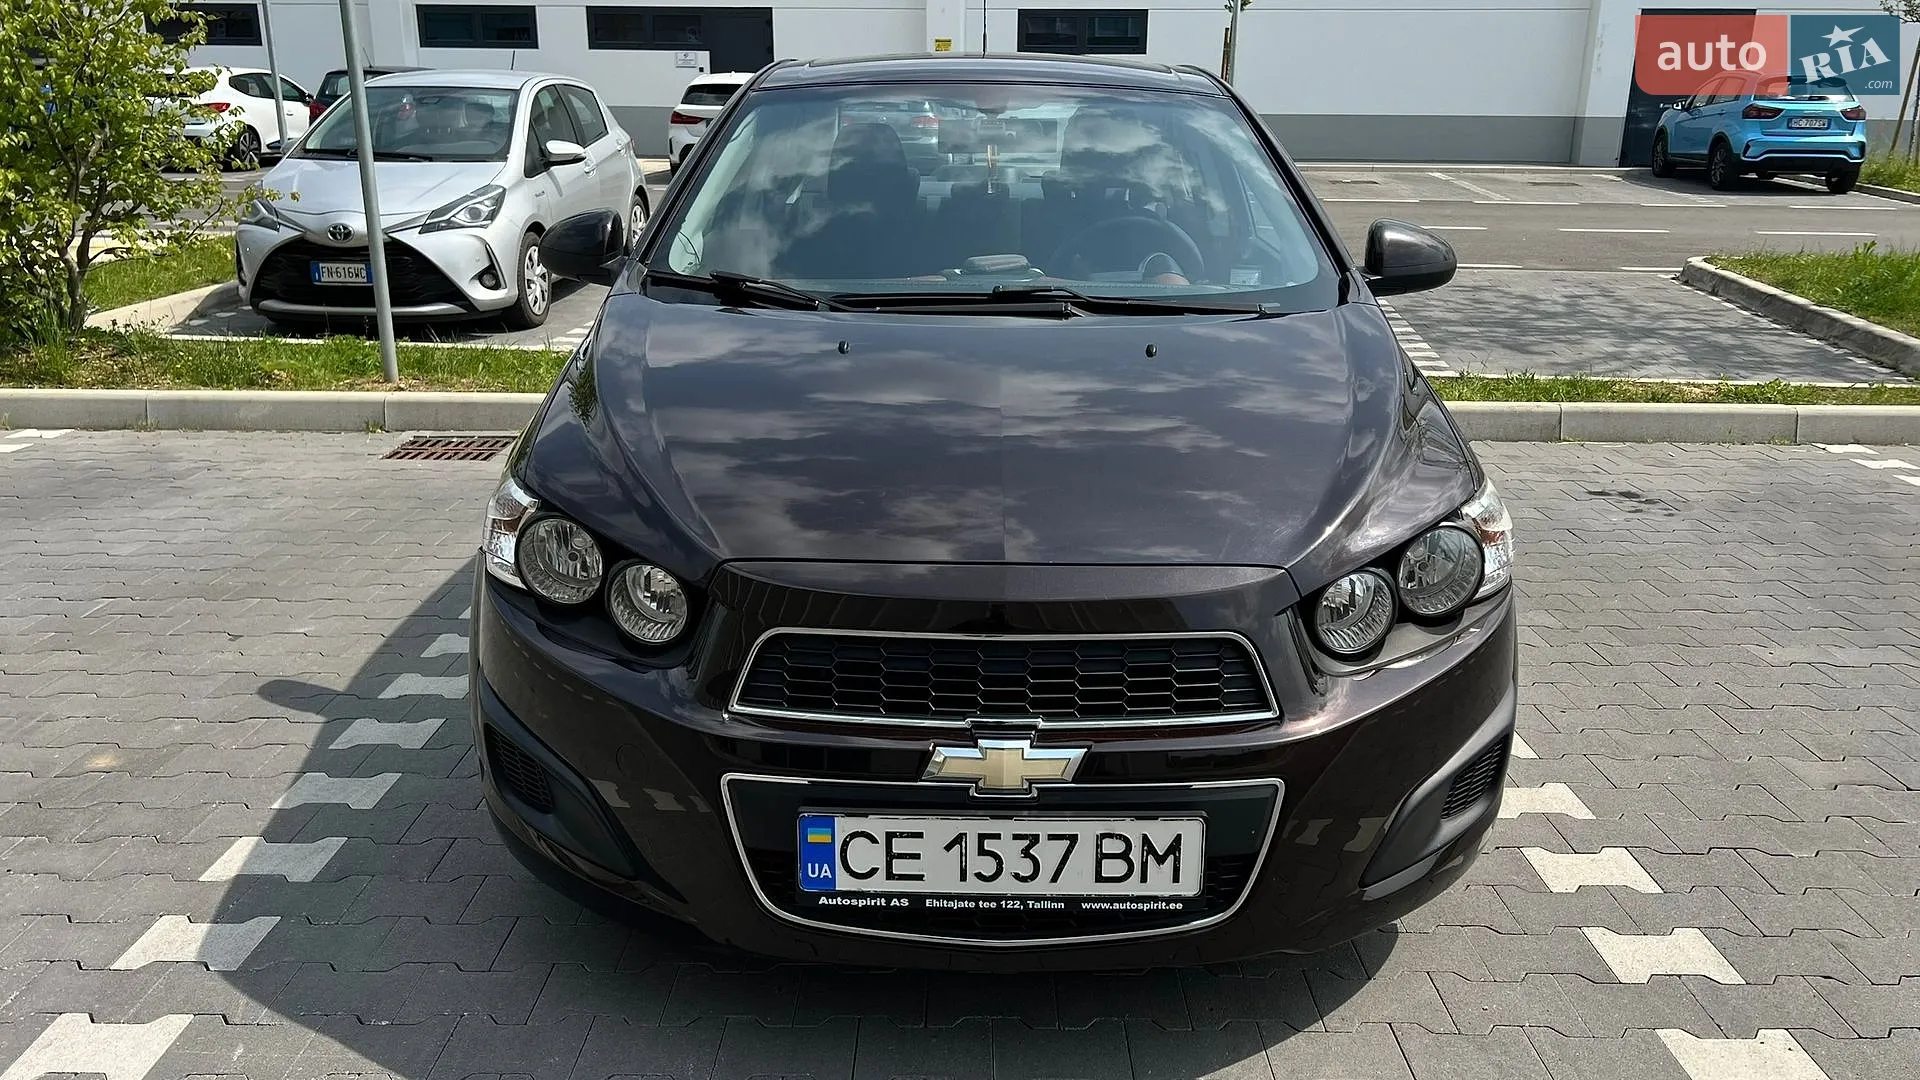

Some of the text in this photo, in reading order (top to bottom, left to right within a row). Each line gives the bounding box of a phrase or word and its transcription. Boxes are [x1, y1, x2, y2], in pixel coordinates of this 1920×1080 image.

[839, 830, 1182, 885] CE 1537 BM
[807, 863, 832, 879] UA
[818, 896, 909, 908] Autospirit AS
[925, 898, 1065, 911] Ehitajate tee 122, Tallinn
[1081, 900, 1183, 911] www.autospirit.ee
